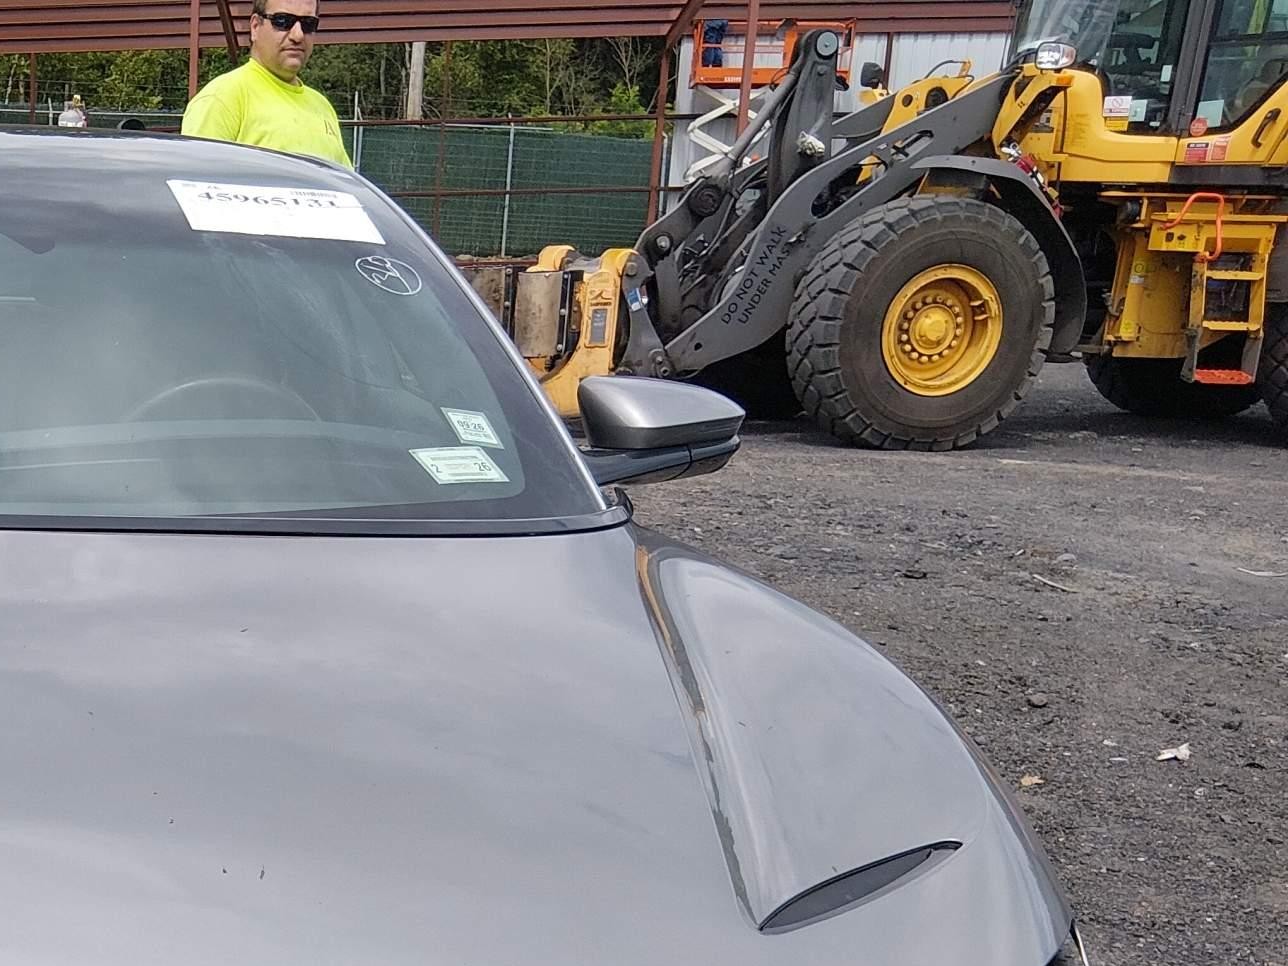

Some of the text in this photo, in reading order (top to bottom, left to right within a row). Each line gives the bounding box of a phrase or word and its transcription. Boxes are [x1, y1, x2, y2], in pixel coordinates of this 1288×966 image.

[198, 190, 341, 209] 45965131
[721, 226, 787, 325] DO NOT WALK
[738, 278, 772, 325] UNDER
